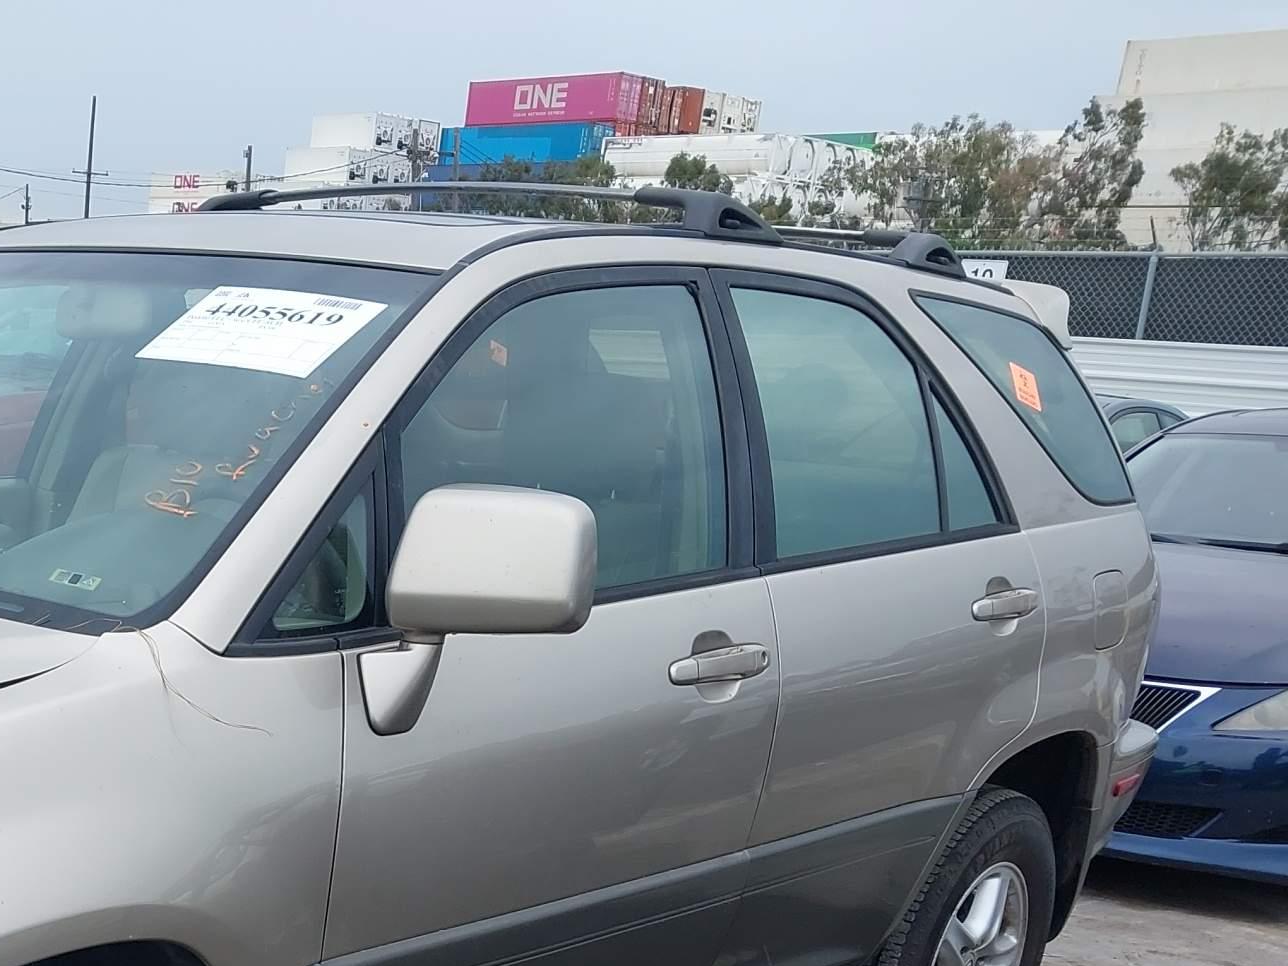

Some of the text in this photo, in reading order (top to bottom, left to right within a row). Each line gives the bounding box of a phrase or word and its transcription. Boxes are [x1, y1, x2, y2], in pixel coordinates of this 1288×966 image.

[513, 82, 569, 110] ONE
[174, 175, 200, 188] ONE
[205, 302, 344, 327] 44055619
